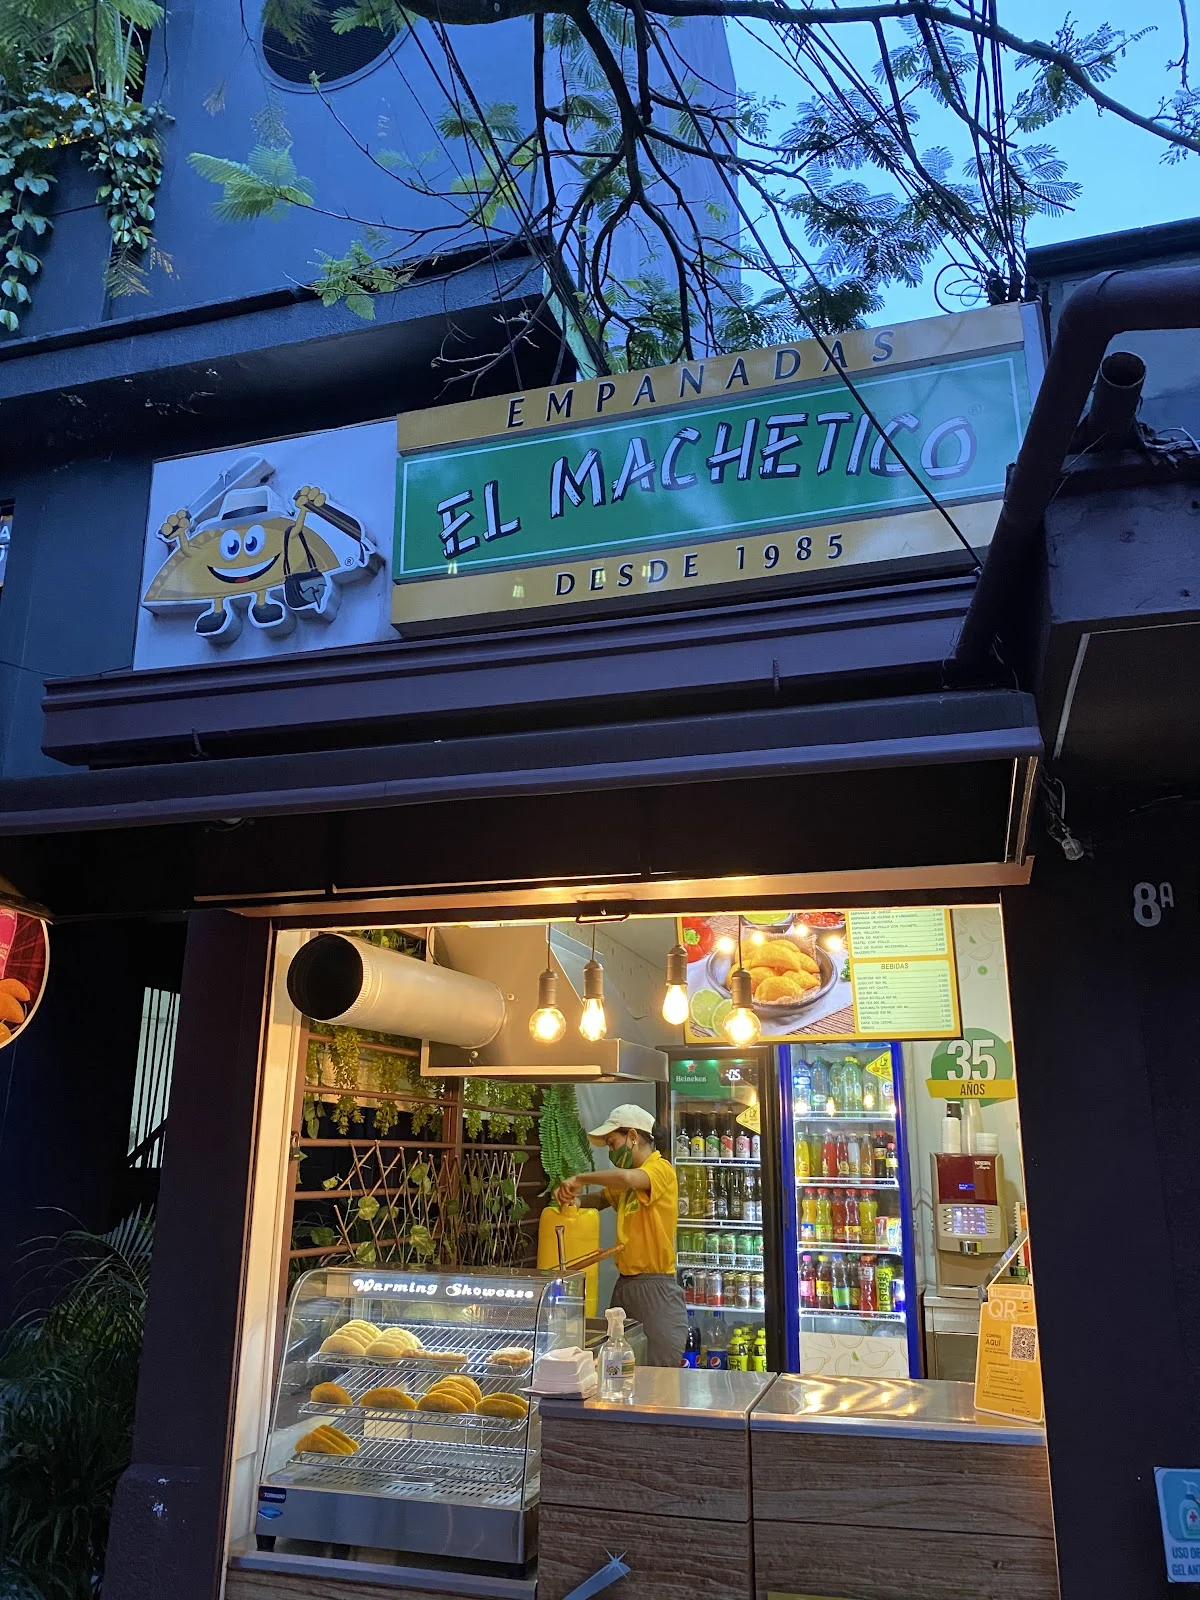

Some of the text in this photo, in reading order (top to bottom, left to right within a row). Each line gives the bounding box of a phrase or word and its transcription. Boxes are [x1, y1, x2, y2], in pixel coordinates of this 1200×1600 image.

[506, 330, 895, 428] EMPANADAS
[437, 411, 977, 559] EL MACHETICO
[555, 534, 844, 598] DESDE 1985
[946, 1039, 996, 1080] 35
[960, 1082, 985, 1095] AÑOS
[352, 1279, 534, 1298] Warming Showcase
[988, 1298, 1016, 1321] QR
[1172, 1547, 1188, 1558] USO
[1172, 1564, 1186, 1576] GEL
